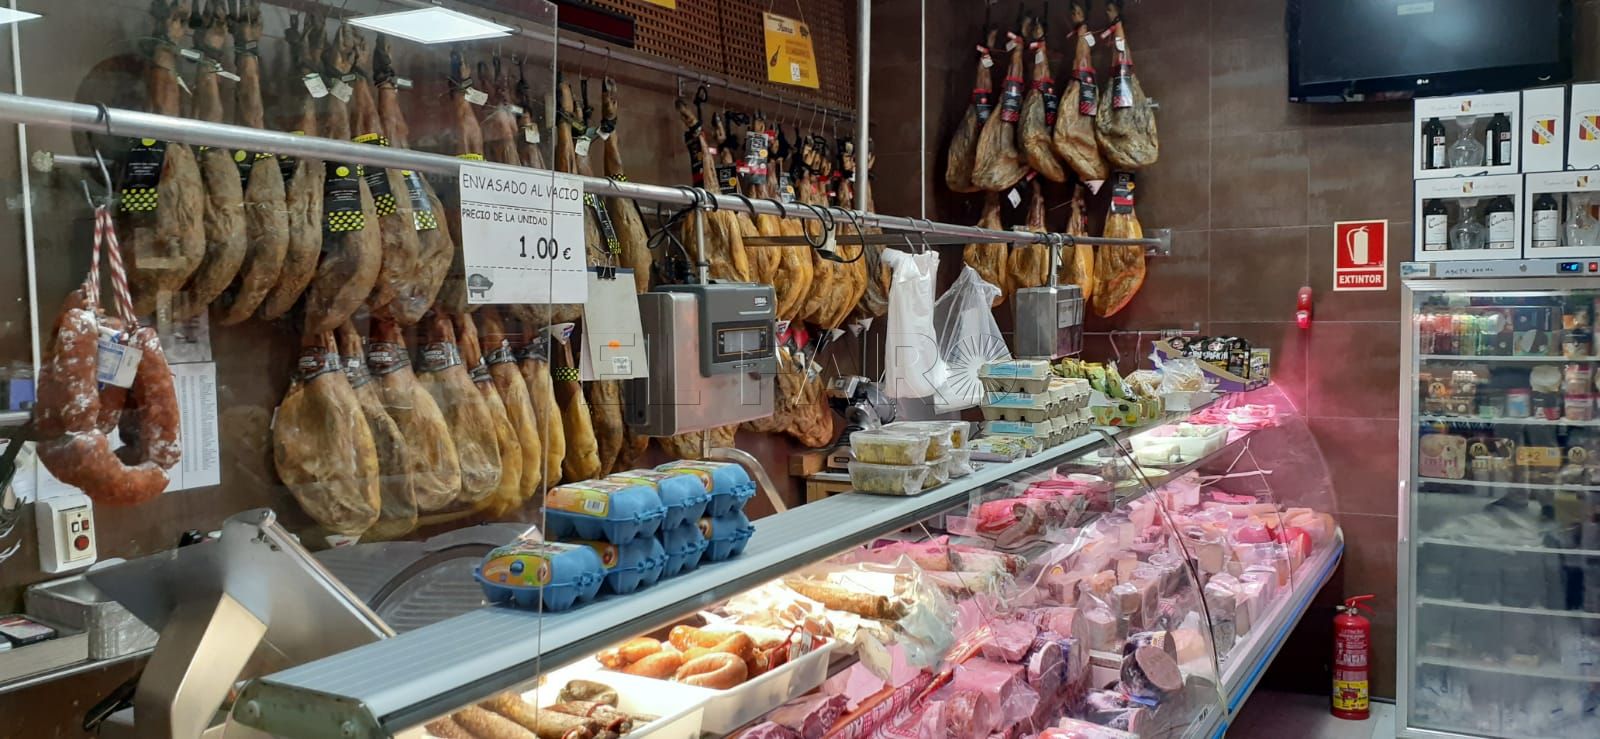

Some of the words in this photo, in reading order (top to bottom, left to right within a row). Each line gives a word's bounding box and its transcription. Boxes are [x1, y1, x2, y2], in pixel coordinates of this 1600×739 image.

[463, 173, 528, 195] ENVASADO
[530, 184, 543, 197] AL
[546, 185, 579, 201] VACIO
[462, 208, 491, 220] PRECIO
[494, 212, 503, 222] DE
[505, 213, 515, 223] LA
[518, 215, 548, 226] UNIDAD
[520, 235, 559, 260] 1.00
[562, 247, 572, 260] €
[1339, 274, 1382, 285] EXTINTOR
